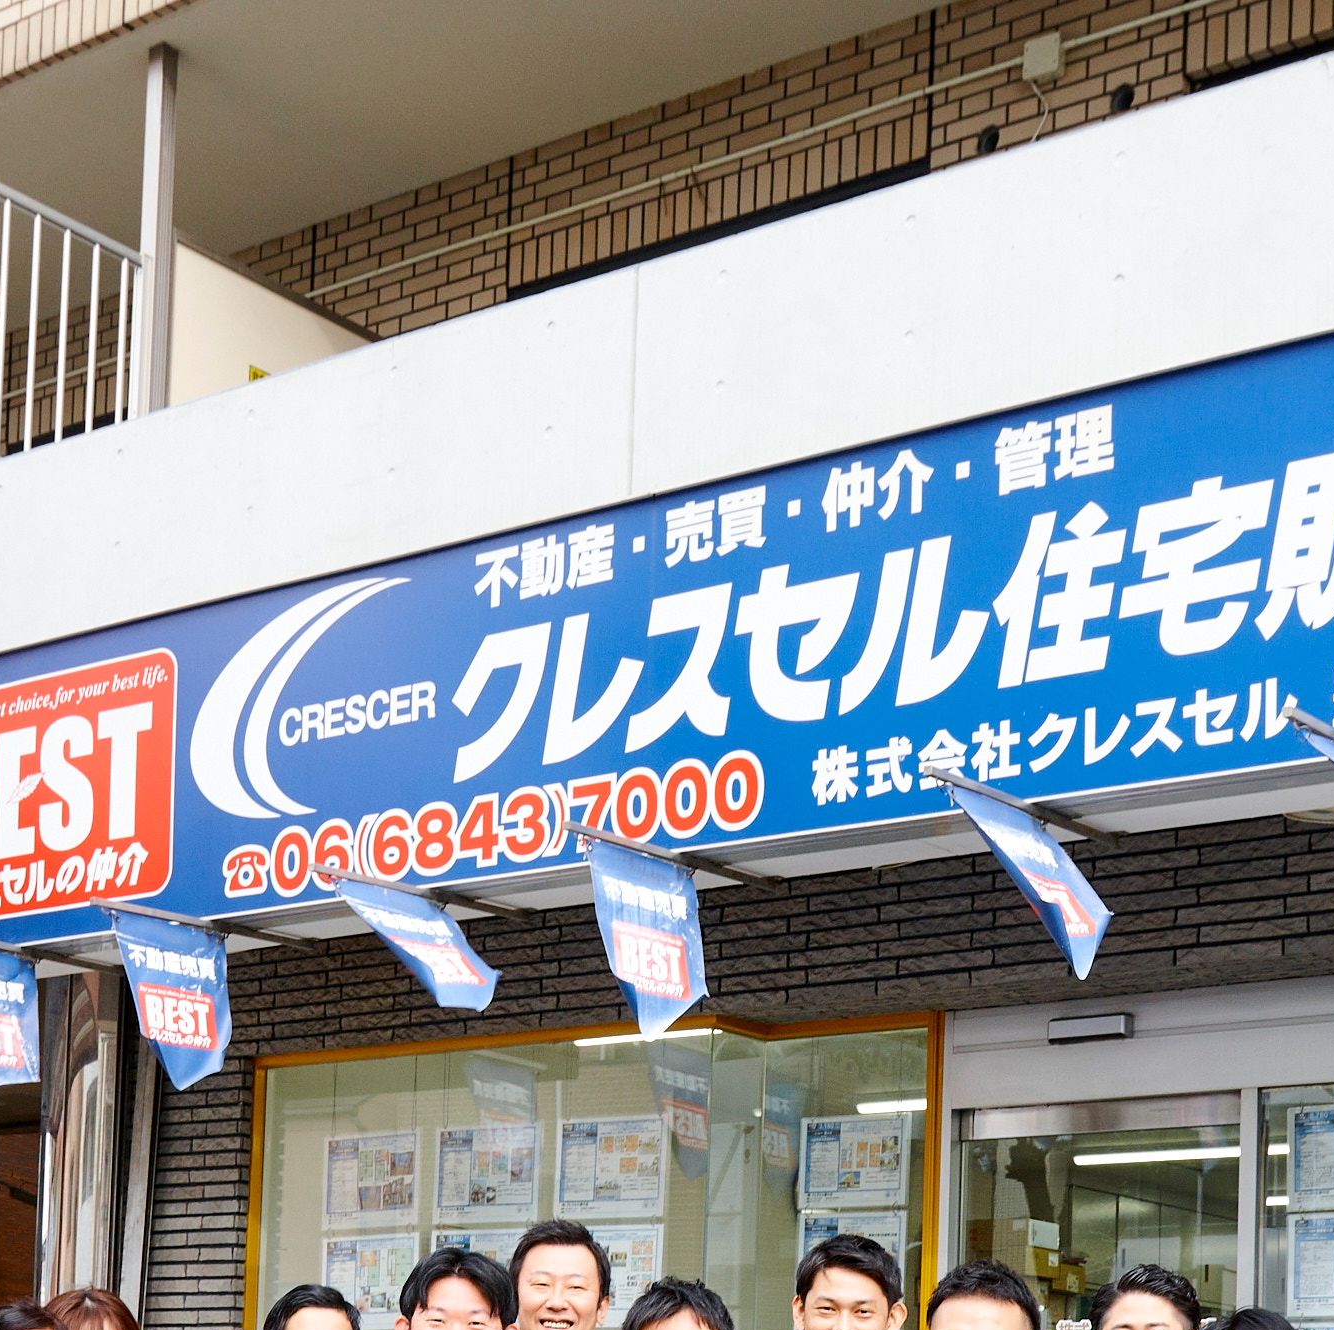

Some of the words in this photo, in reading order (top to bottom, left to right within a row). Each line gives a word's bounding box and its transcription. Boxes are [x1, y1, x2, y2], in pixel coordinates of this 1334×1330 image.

[76, 682, 109, 705] your
[112, 670, 138, 692] best
[141, 664, 169, 690] life.
[278, 680, 436, 747] CRESCER
[811, 676, 1300, 806] 株式会社クレスセル
[272, 750, 764, 897] 06(6843)7000
[620, 934, 682, 984] BEST
[145, 993, 210, 1037] BEST
